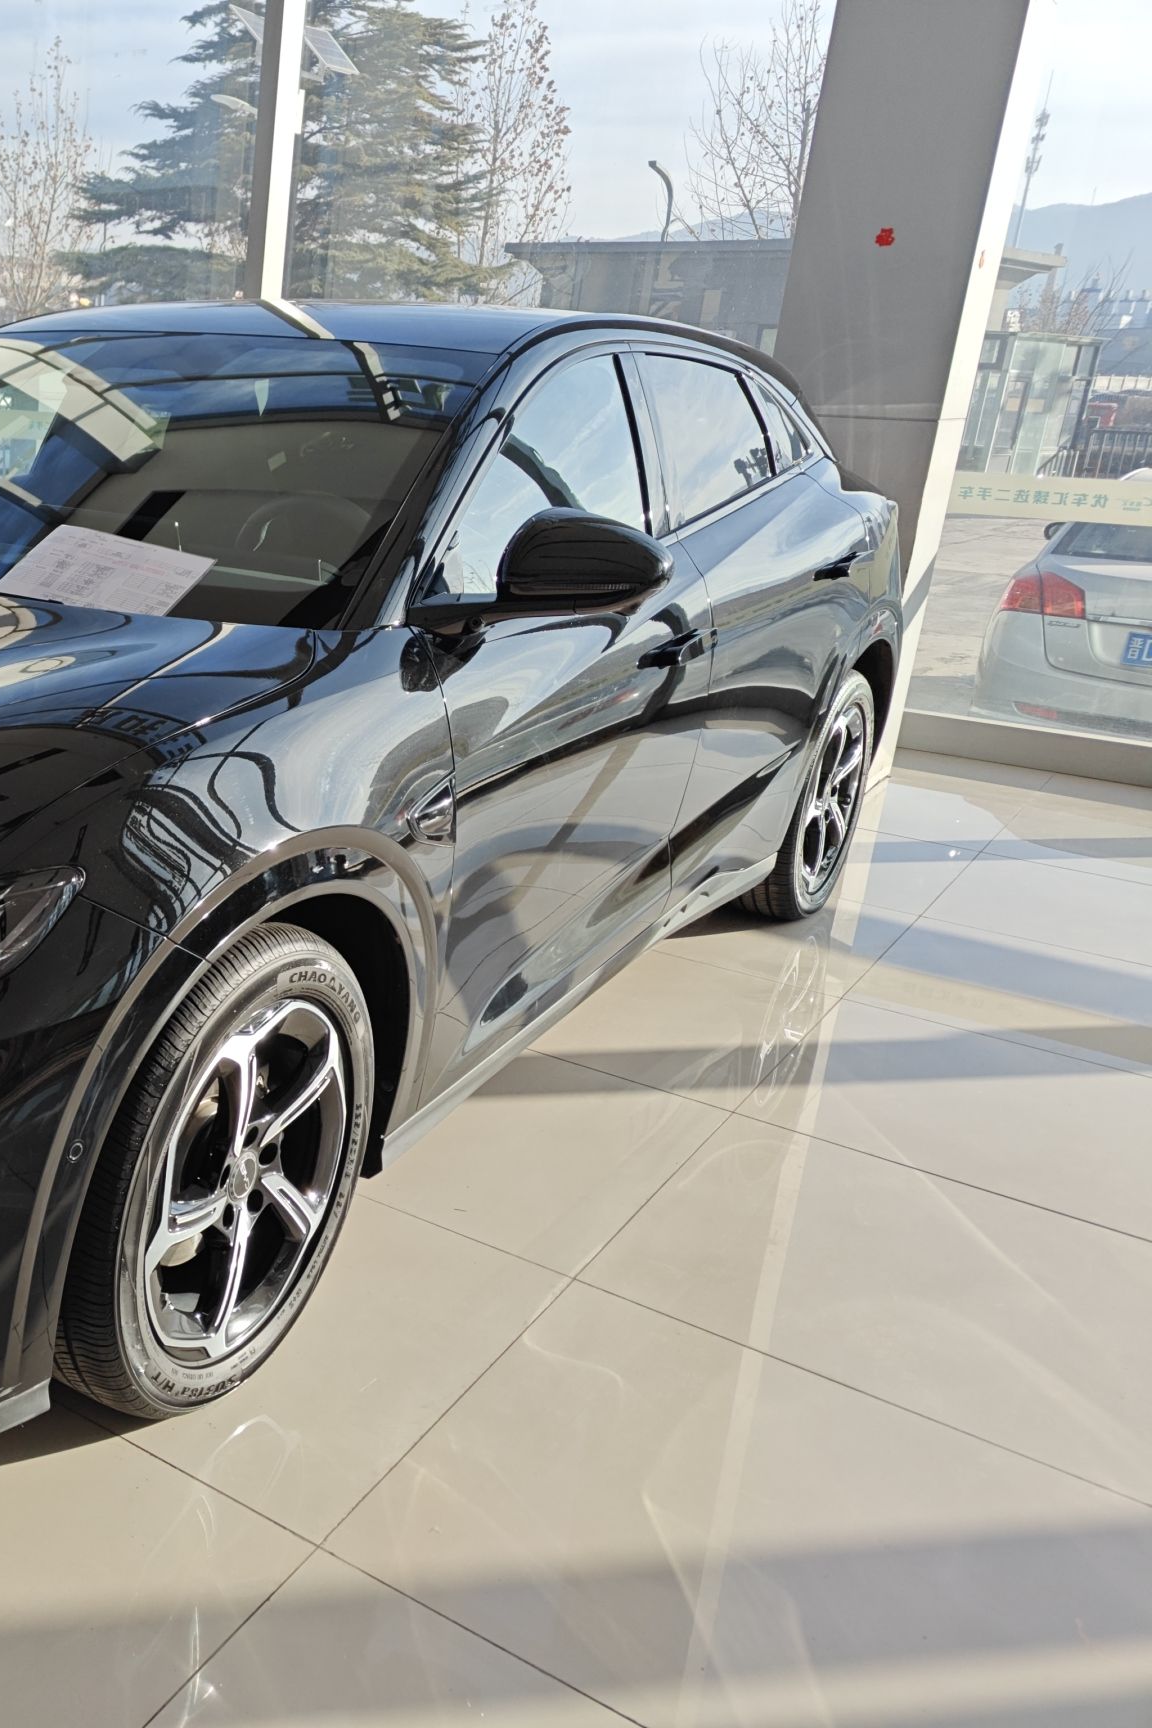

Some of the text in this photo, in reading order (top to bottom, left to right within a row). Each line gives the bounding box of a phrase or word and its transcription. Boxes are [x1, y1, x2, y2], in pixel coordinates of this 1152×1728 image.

[288, 970, 362, 1024] CHAO YANG
[150, 1371, 176, 1394] H/T
